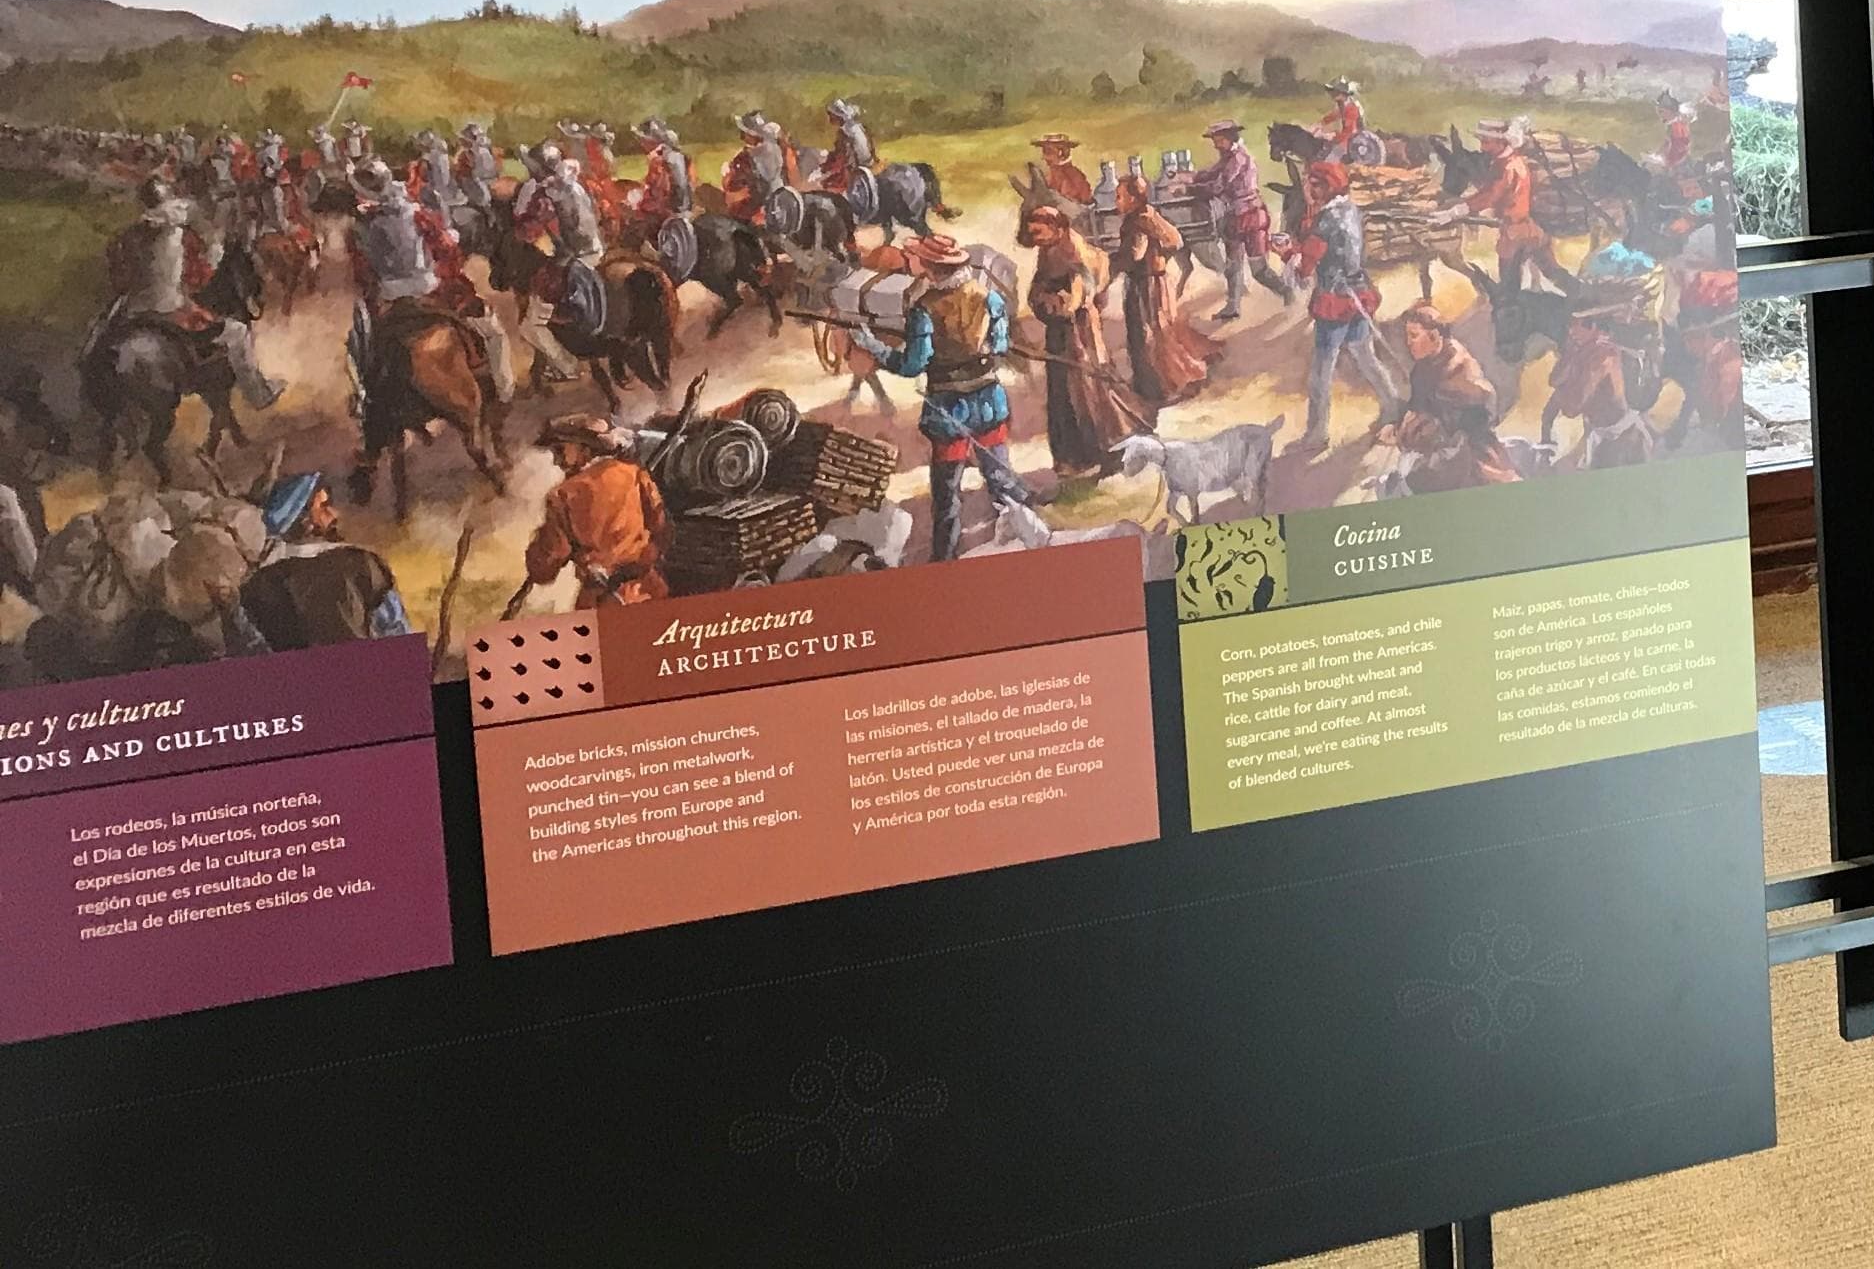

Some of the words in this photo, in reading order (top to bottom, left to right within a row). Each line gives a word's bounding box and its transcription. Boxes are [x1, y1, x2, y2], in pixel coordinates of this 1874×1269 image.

[1333, 521, 1401, 548] Cocina
[1334, 548, 1434, 577] CUISINE
[652, 609, 814, 650] Arquitectura
[657, 629, 877, 677] ARCHITECTURE
[1220, 648, 1257, 663] Corn,
[1259, 638, 1319, 659] potatoes,
[1322, 628, 1385, 647] tomatoes,
[1387, 620, 1411, 636] and
[1413, 616, 1443, 632] chile
[38, 715, 59, 746] y
[66, 697, 186, 733] culturas
[82, 739, 144, 764] AND
[156, 714, 304, 752] CULTURES
[524, 752, 576, 771] Adobe
[578, 744, 628, 762] bricks,
[631, 735, 687, 754] mission
[690, 725, 760, 745] churches,
[70, 827, 101, 842] Los
[104, 818, 168, 837] rodeos,
[171, 811, 187, 826] la
[190, 803, 248, 824] música
[252, 792, 322, 814] norteña,
